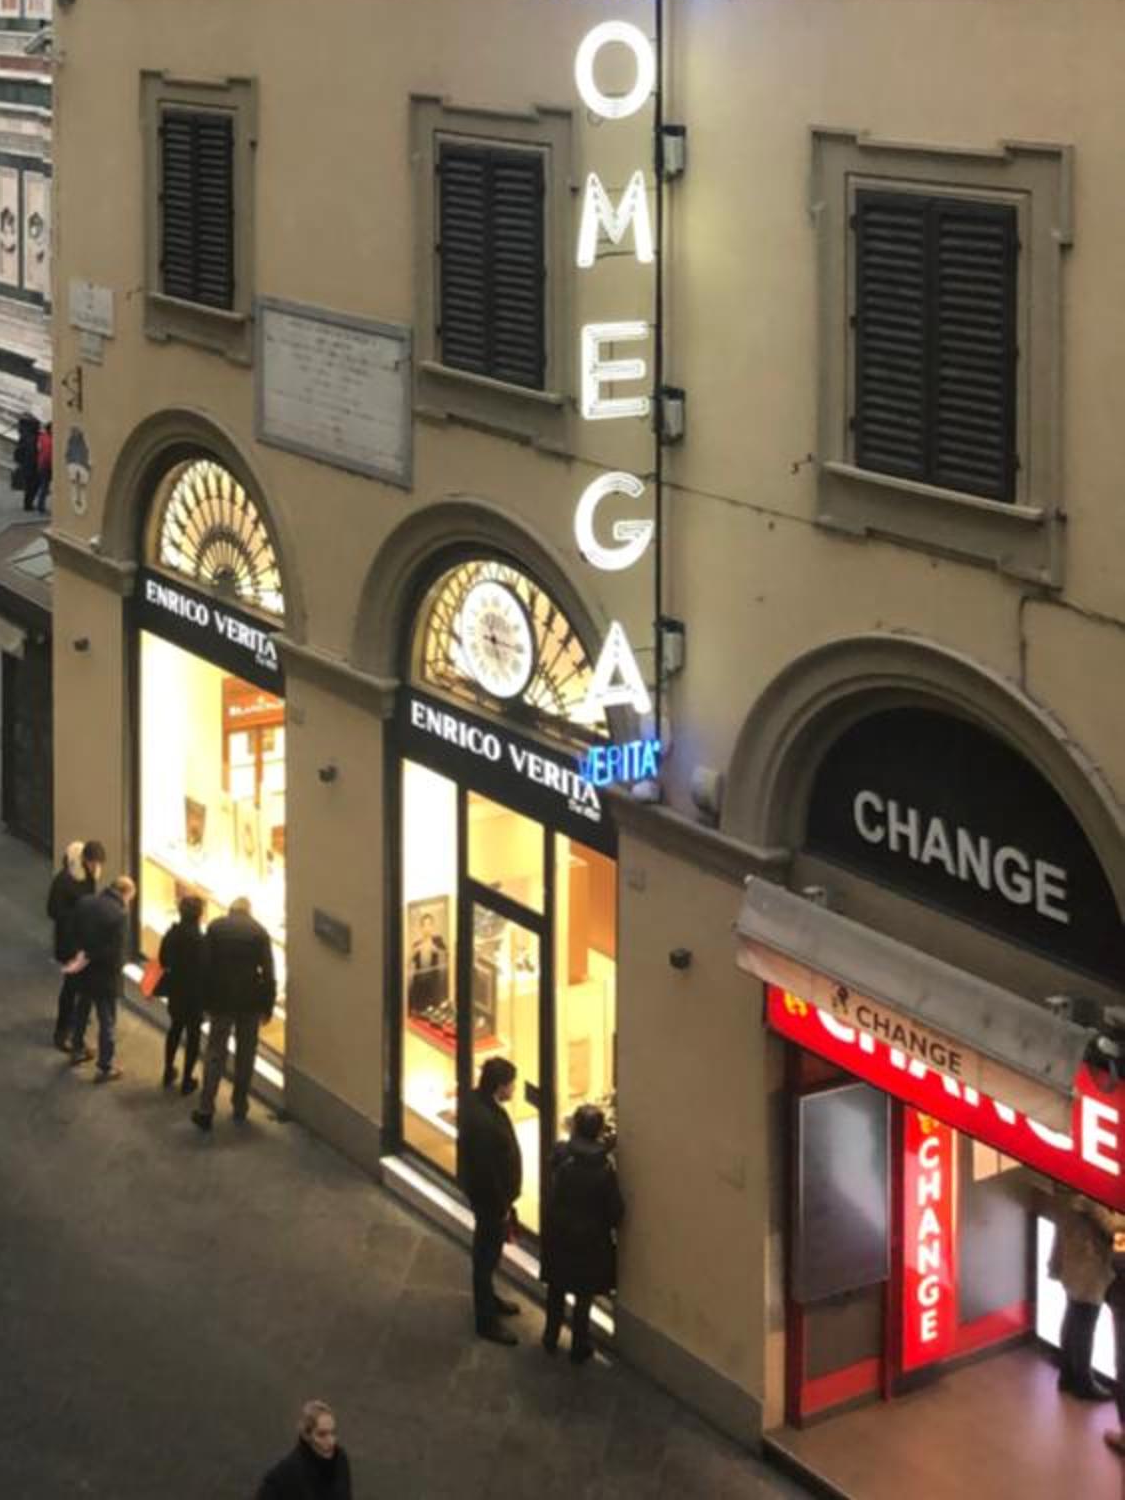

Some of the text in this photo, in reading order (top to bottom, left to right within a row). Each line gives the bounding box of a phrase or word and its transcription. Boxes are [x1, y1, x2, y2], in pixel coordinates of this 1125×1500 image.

[574, 20, 657, 714] OMEGA
[145, 579, 210, 627] ENRICO
[410, 700, 502, 762] ENRICO
[853, 790, 1069, 925] CHANGE
[855, 1004, 963, 1075] CHANGE
[917, 1136, 940, 1343] CHANGE
